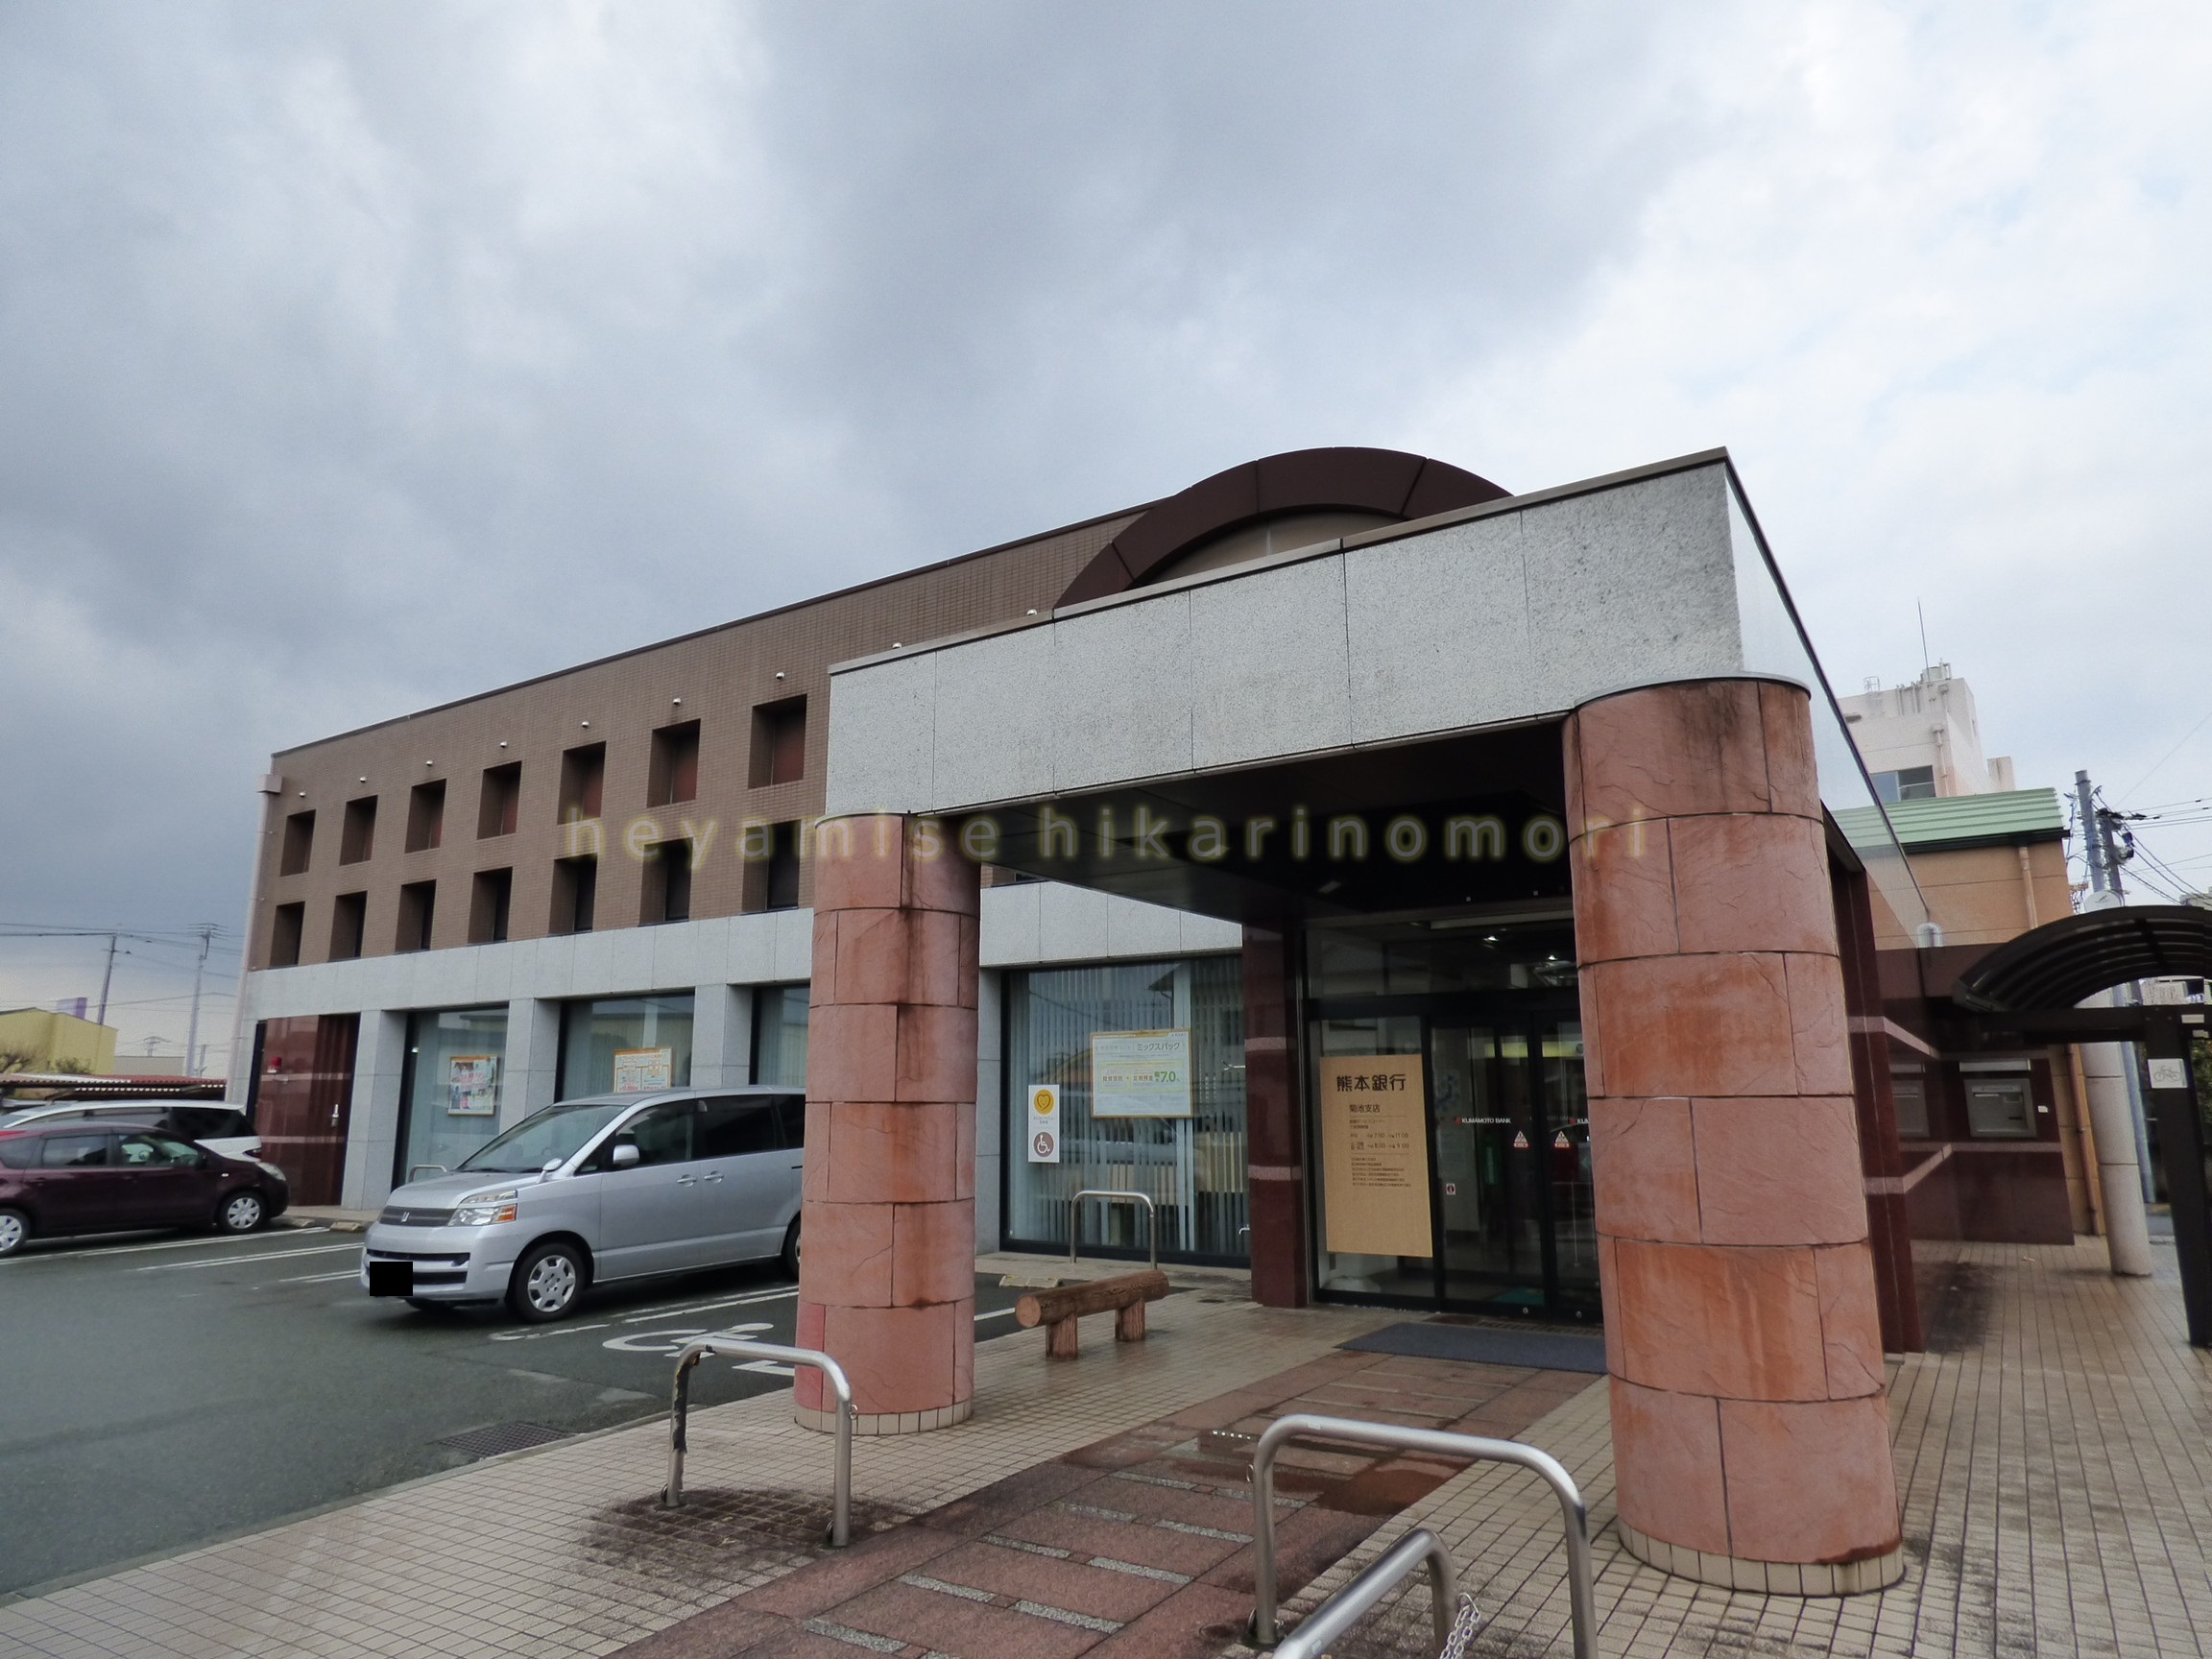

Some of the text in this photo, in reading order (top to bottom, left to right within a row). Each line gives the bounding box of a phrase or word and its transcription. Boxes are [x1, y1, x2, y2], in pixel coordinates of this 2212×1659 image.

[1137, 1042, 1181, 1051] ミックスパック
[1335, 1073, 1407, 1092] 熊本銀行
